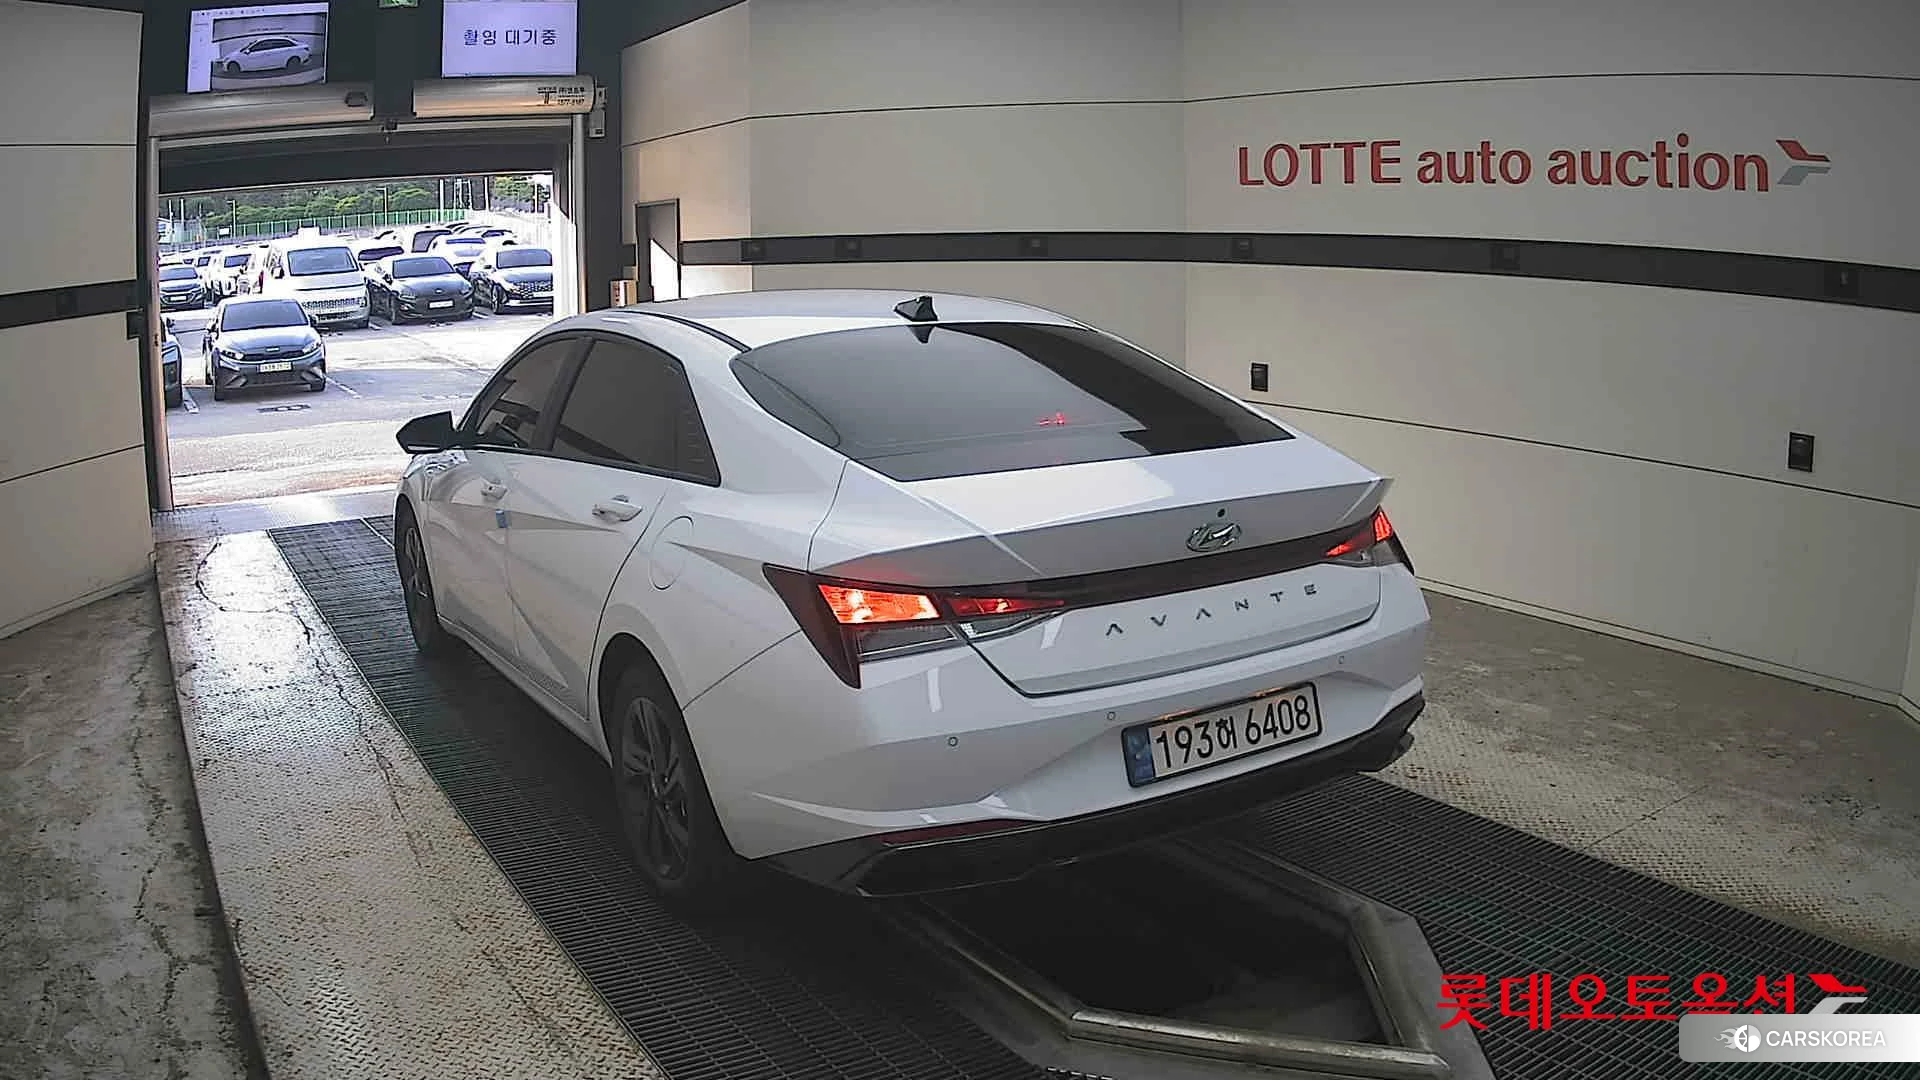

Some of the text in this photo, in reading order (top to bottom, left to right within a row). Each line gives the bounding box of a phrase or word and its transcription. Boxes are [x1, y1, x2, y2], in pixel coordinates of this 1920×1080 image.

[463, 29, 557, 46] 촬영 대기중
[1238, 132, 1769, 193] LOTTE auto auction
[1105, 583, 1318, 637] AVANTE
[1155, 694, 1312, 769] 193허 6408
